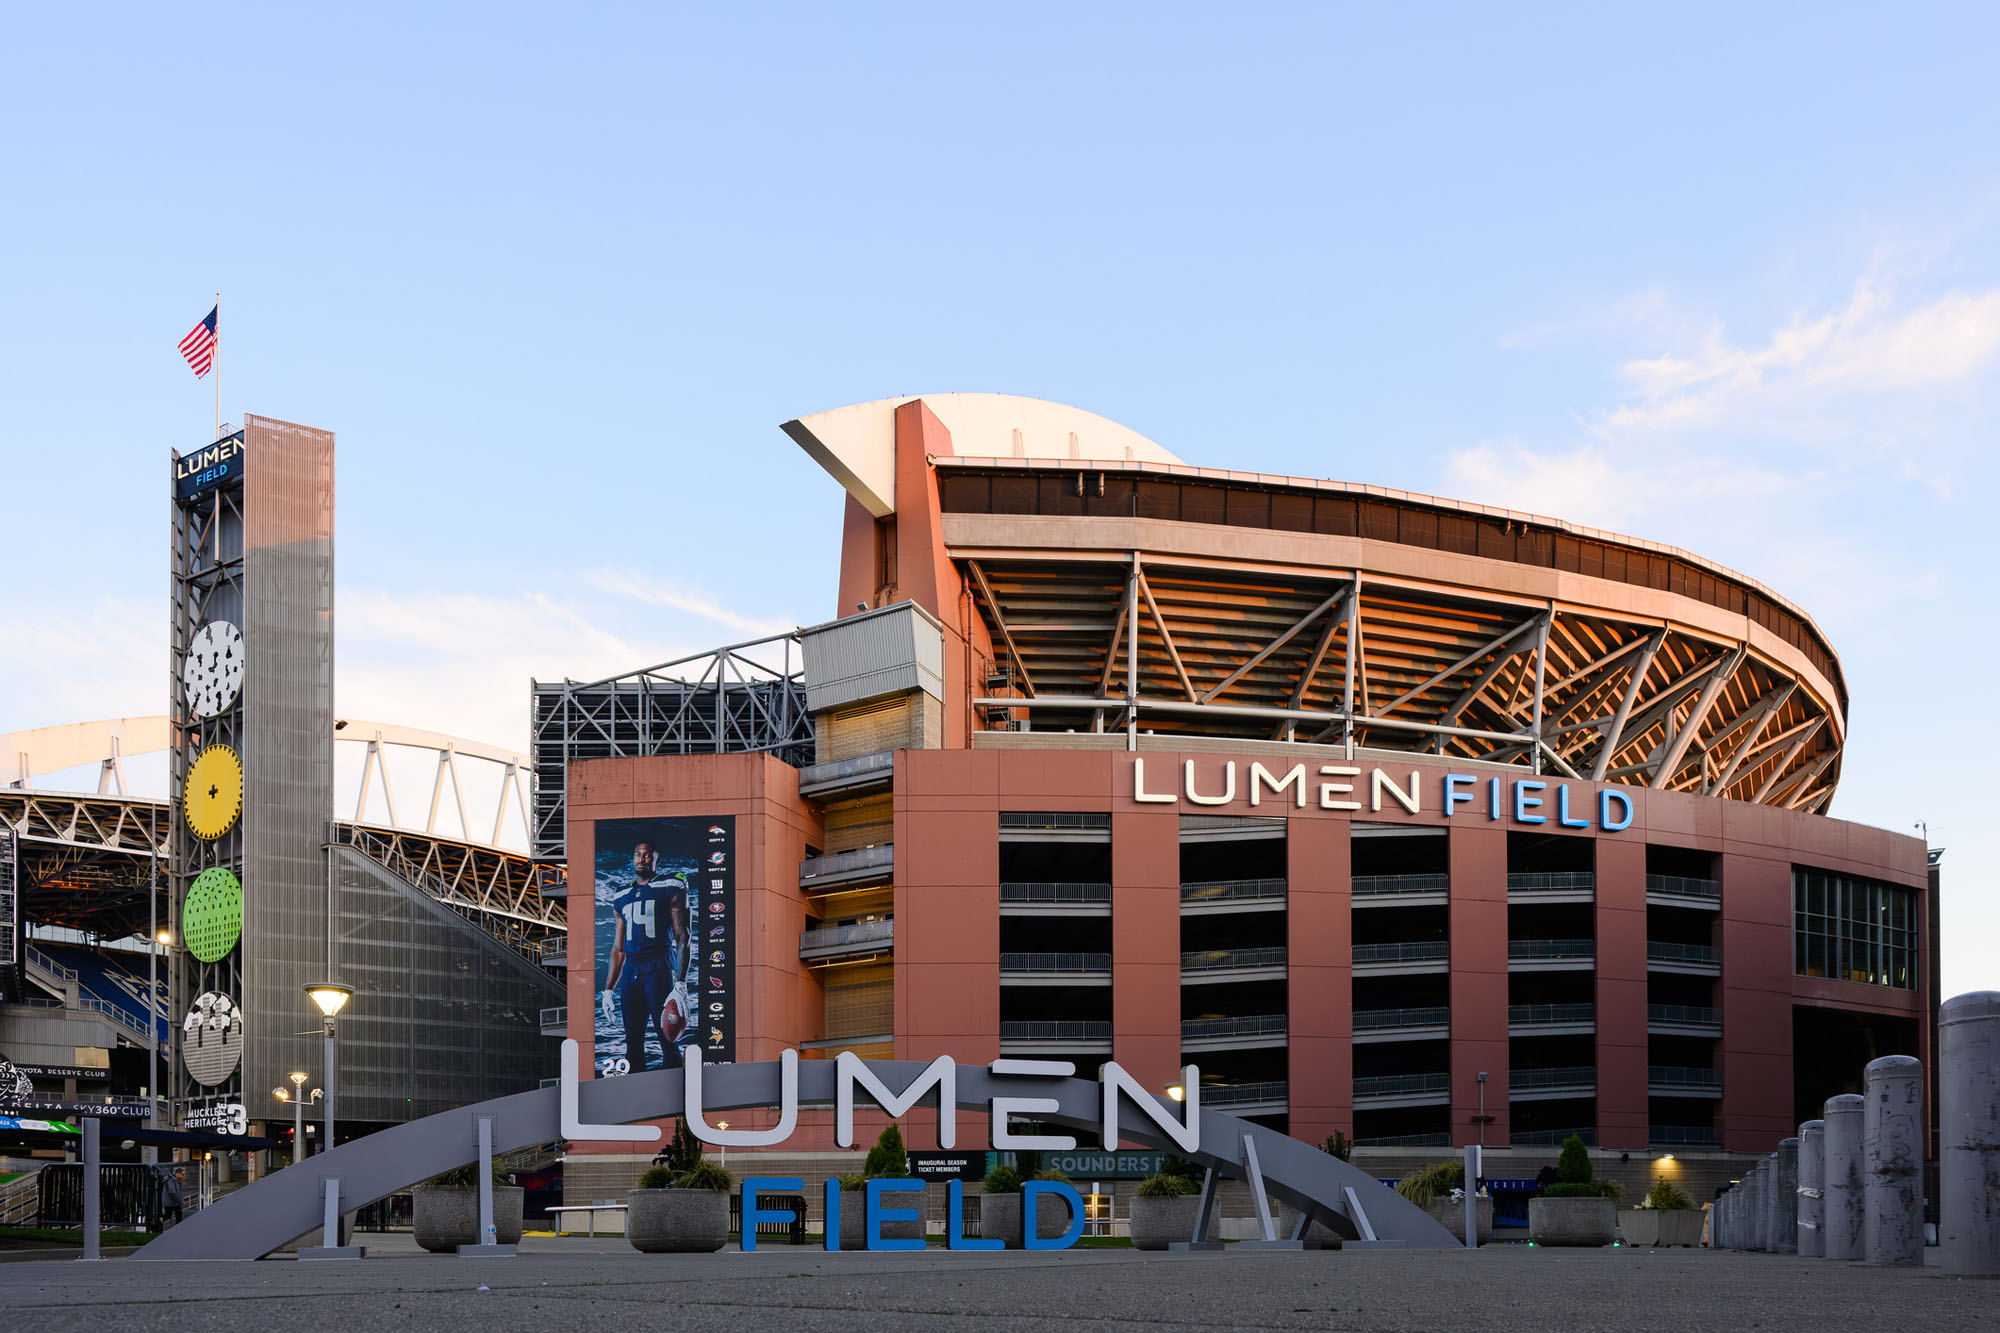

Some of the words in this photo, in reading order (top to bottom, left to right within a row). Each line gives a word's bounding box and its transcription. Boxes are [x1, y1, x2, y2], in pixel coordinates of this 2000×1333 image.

[177, 438, 245, 480] LUMEN
[196, 464, 228, 487] FIELD
[1134, 757, 1420, 815] LUMEN
[1443, 773, 1635, 832] FIELD
[621, 899, 656, 942] 14
[47, 1068, 82, 1077] RESERVE
[84, 1070, 106, 1078] CLUB
[602, 1058, 630, 1077] 20
[561, 1039, 1199, 1152] LUMEN
[121, 1106, 151, 1117] CLUB
[226, 1103, 247, 1136] 3
[917, 1159, 946, 1167] INAUGURAL
[1050, 1156, 1149, 1173] SOUNDERS
[739, 1177, 1085, 1252] FIELD
